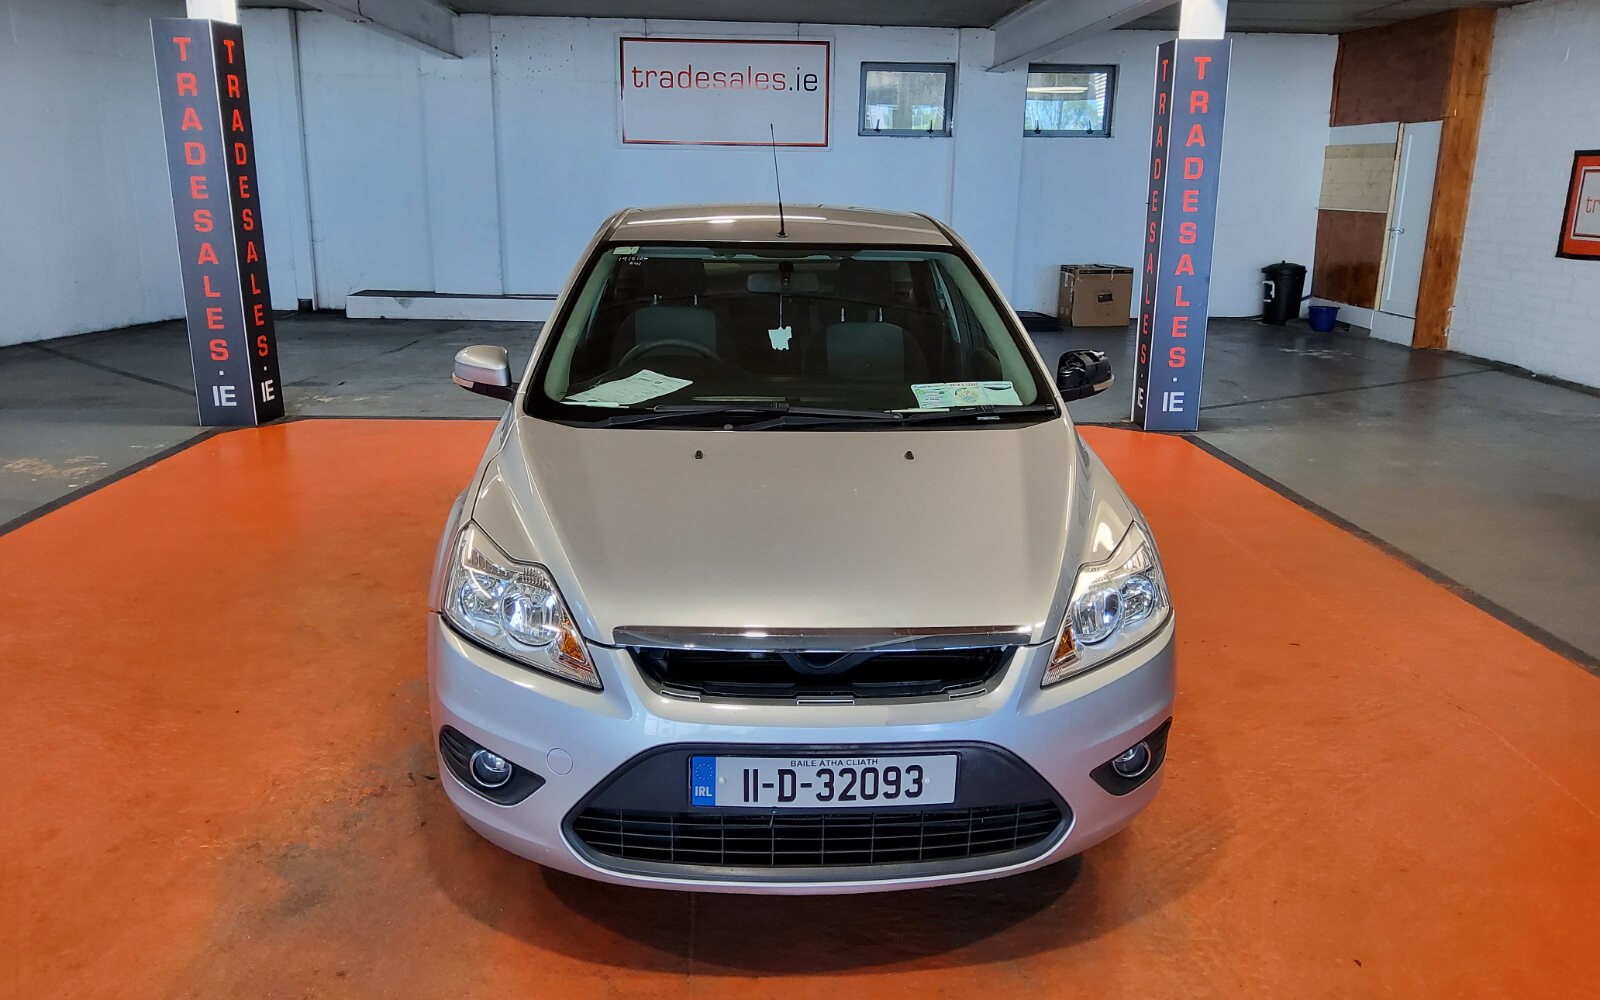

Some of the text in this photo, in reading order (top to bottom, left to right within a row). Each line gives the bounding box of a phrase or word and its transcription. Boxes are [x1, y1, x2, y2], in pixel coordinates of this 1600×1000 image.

[631, 64, 818, 92] tradesales.ie
[846, 758, 878, 766] CLIATH
[694, 786, 713, 798] IRL
[743, 764, 924, 803] 11-D-32093
